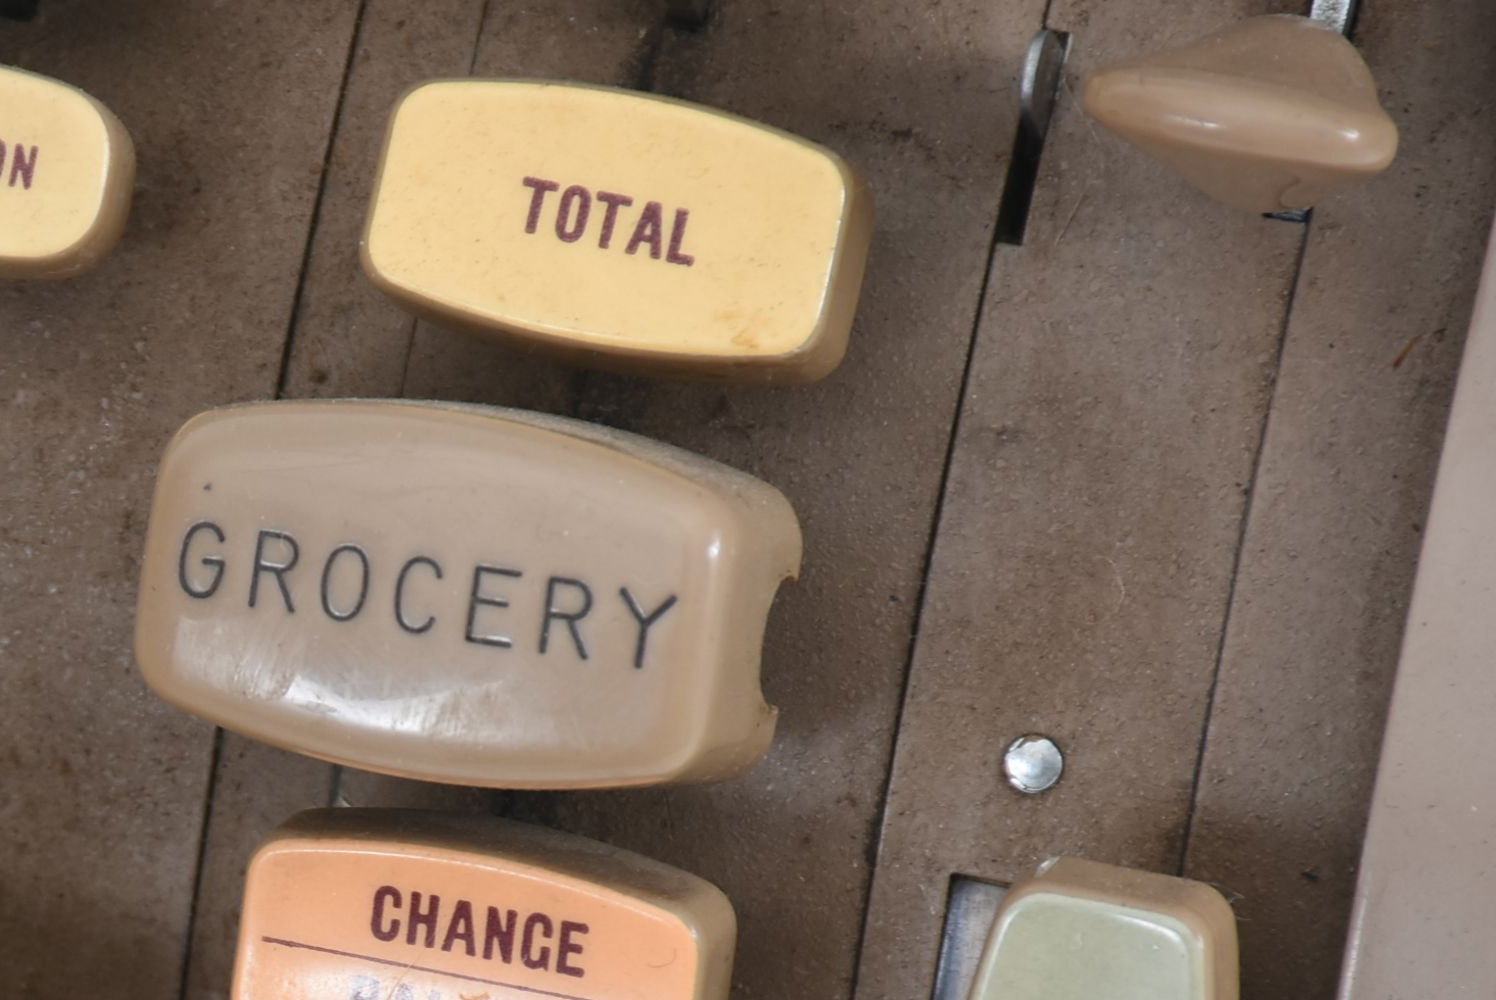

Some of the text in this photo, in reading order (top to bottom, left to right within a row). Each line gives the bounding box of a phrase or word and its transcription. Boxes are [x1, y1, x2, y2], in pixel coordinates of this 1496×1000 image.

[521, 176, 695, 267] TOTAL
[177, 520, 678, 670] GROCERY
[368, 884, 589, 980] CHANGE
